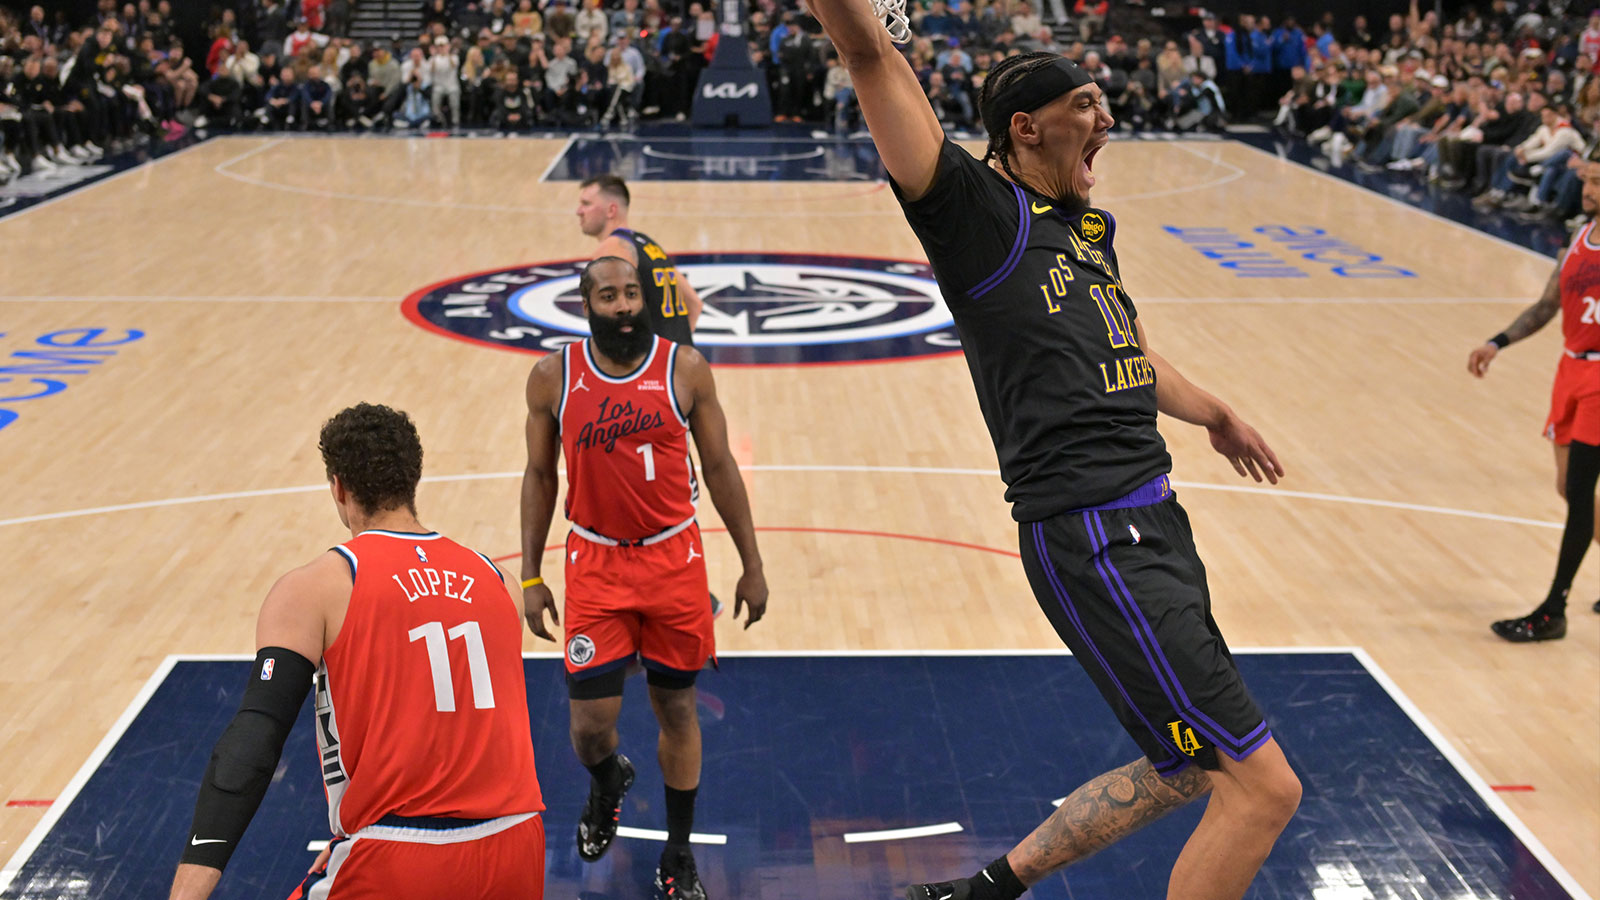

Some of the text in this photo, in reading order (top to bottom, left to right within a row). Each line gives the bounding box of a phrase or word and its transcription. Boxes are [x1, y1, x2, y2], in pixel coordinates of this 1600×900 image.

[442, 261, 592, 318] ANGEL
[652, 267, 689, 318] 77
[1039, 254, 1075, 315] LOS
[1099, 355, 1155, 394] LAKERS
[576, 407, 665, 454] Angeles
[596, 396, 636, 425] Los
[636, 443, 656, 482] 1
[391, 567, 475, 604] LOPEZ
[408, 620, 496, 712] 11
